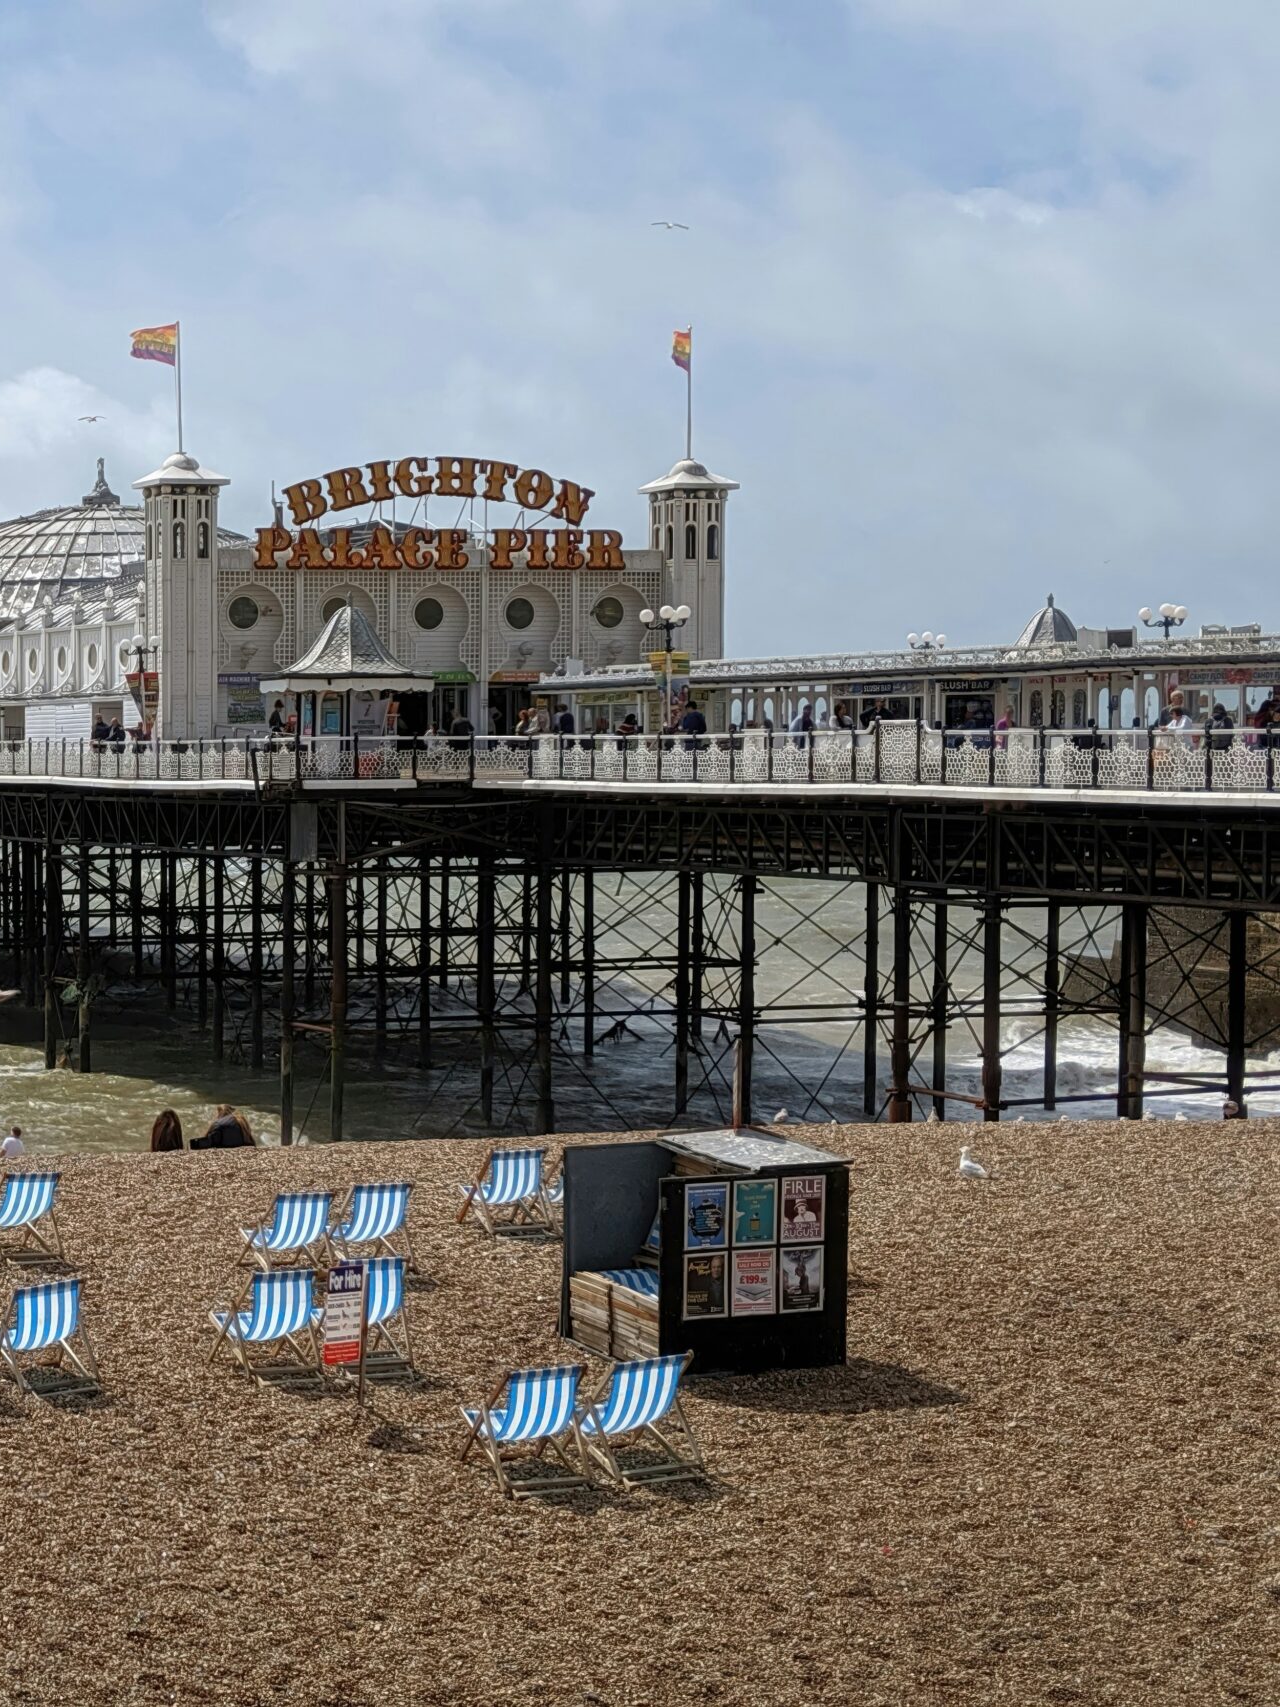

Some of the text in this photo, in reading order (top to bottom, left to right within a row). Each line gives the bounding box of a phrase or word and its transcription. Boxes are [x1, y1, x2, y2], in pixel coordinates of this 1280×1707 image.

[282, 456, 596, 527] BRIGHTON
[254, 527, 626, 570] PALACE PIER
[863, 684, 892, 692] SLUSH BAR
[940, 681, 969, 690] SLUSH
[784, 1179, 822, 1194] FIRLE
[783, 1229, 819, 1237] AUGUST
[329, 1269, 361, 1290] For Hire
